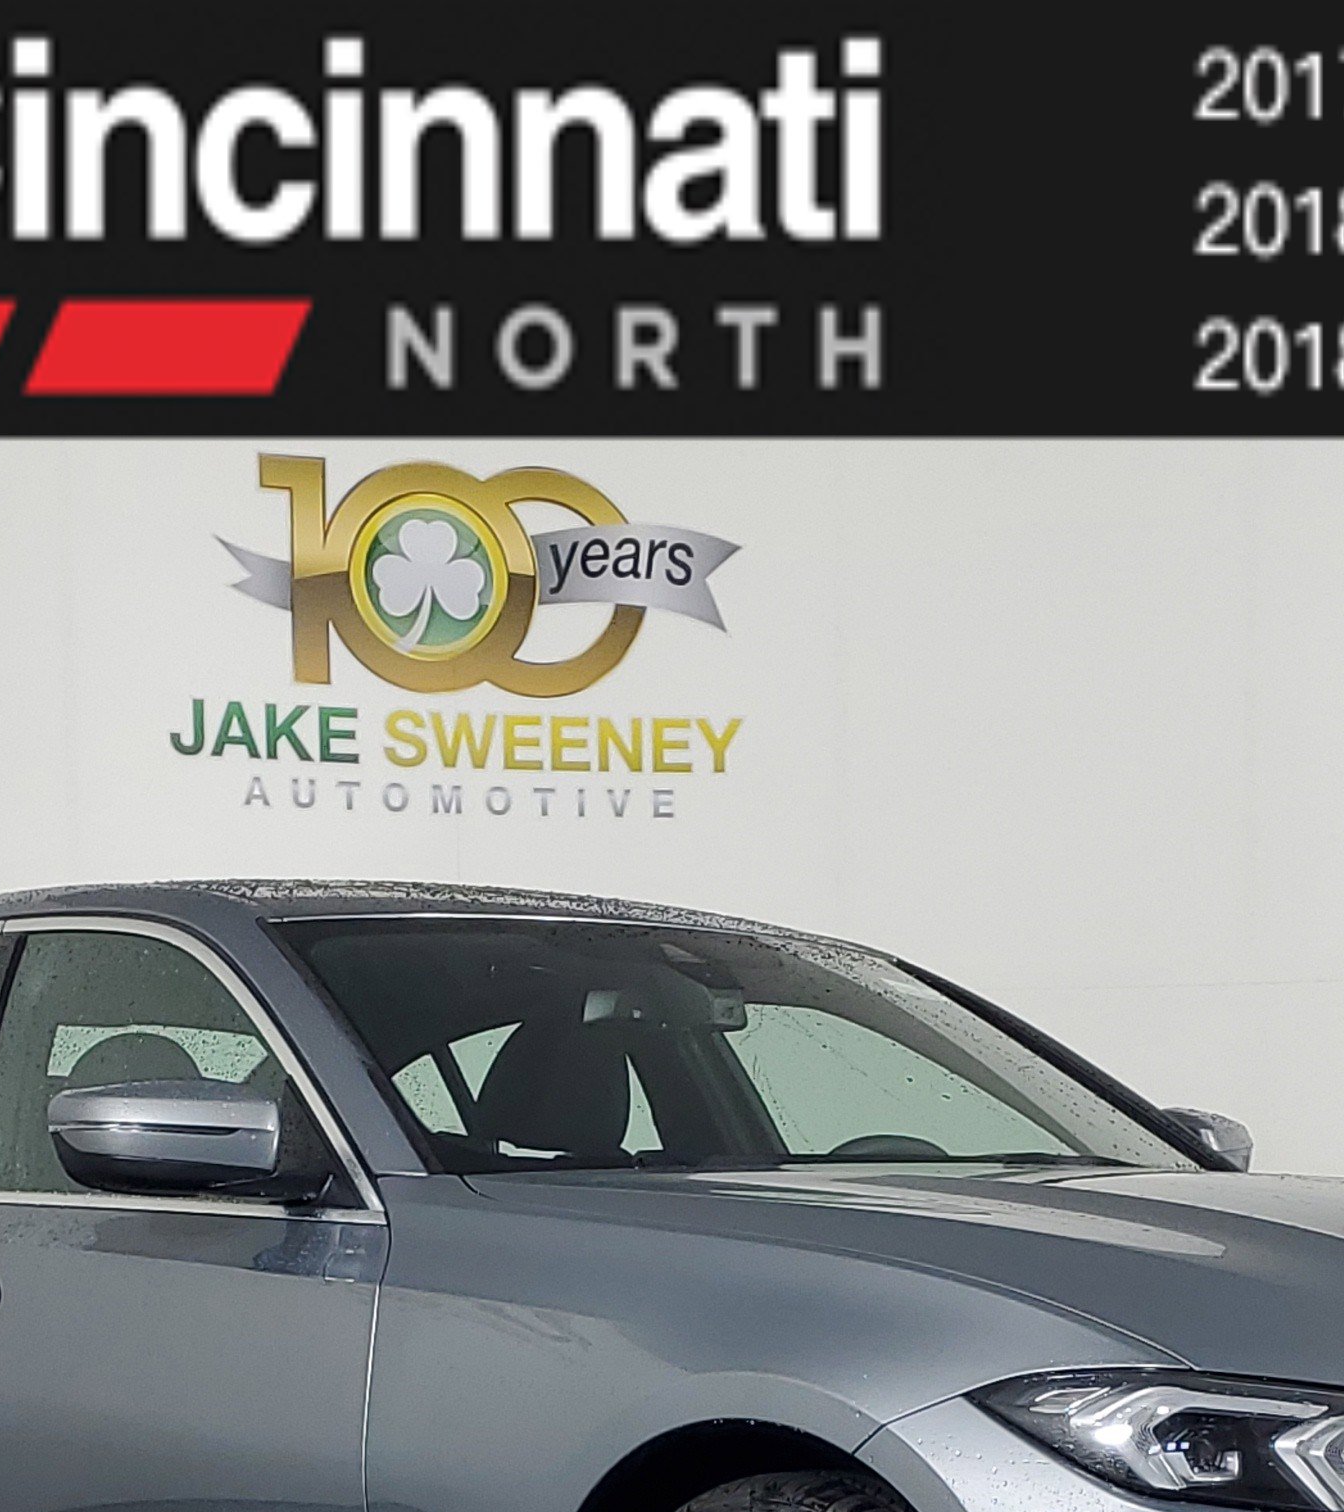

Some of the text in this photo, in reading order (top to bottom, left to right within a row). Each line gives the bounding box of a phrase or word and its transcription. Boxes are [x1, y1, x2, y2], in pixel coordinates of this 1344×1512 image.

[257, 452, 647, 699] 100
[547, 535, 695, 595] years
[169, 698, 744, 774] JAKE SWEENEY
[243, 776, 676, 819] AUTOMOTIVE
